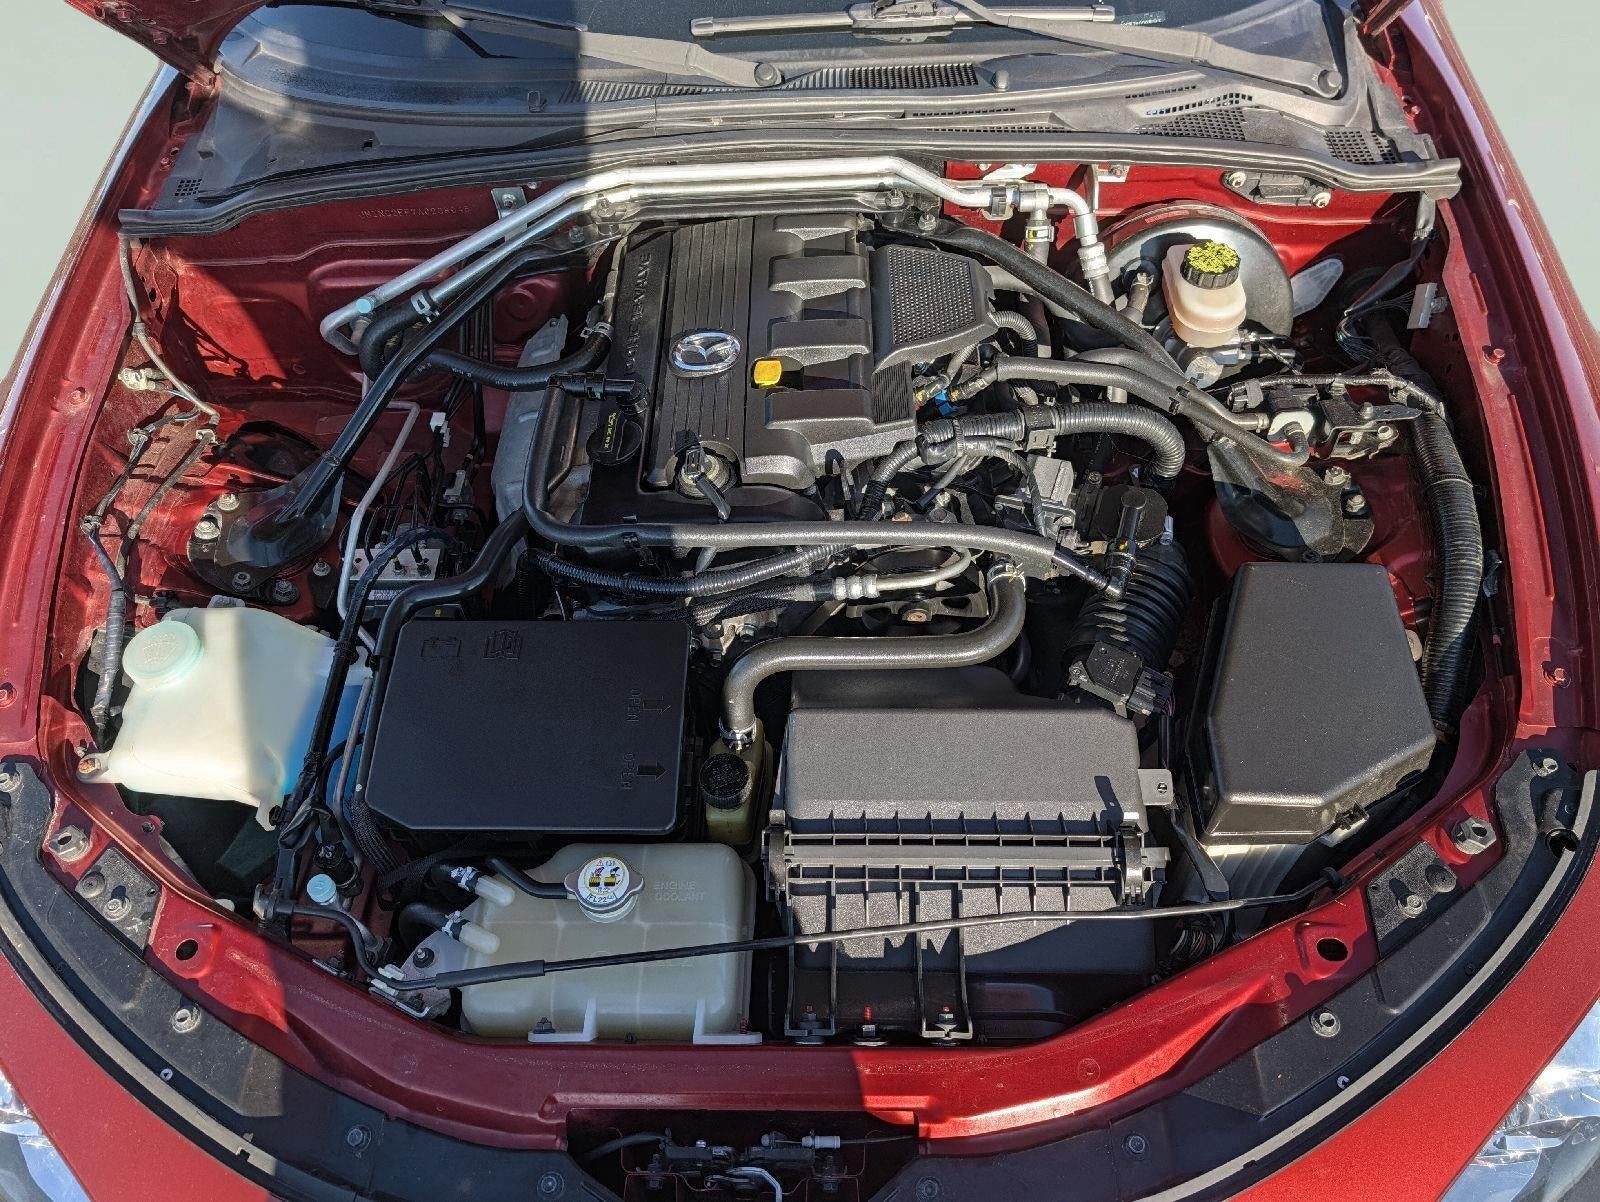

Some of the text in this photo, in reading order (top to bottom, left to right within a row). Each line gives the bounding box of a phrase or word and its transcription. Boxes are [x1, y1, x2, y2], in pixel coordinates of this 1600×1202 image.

[625, 688, 640, 722] OPEN
[621, 752, 636, 791] OPEN
[655, 880, 697, 890] ENGINE
[655, 891, 706, 902] COOLANT
